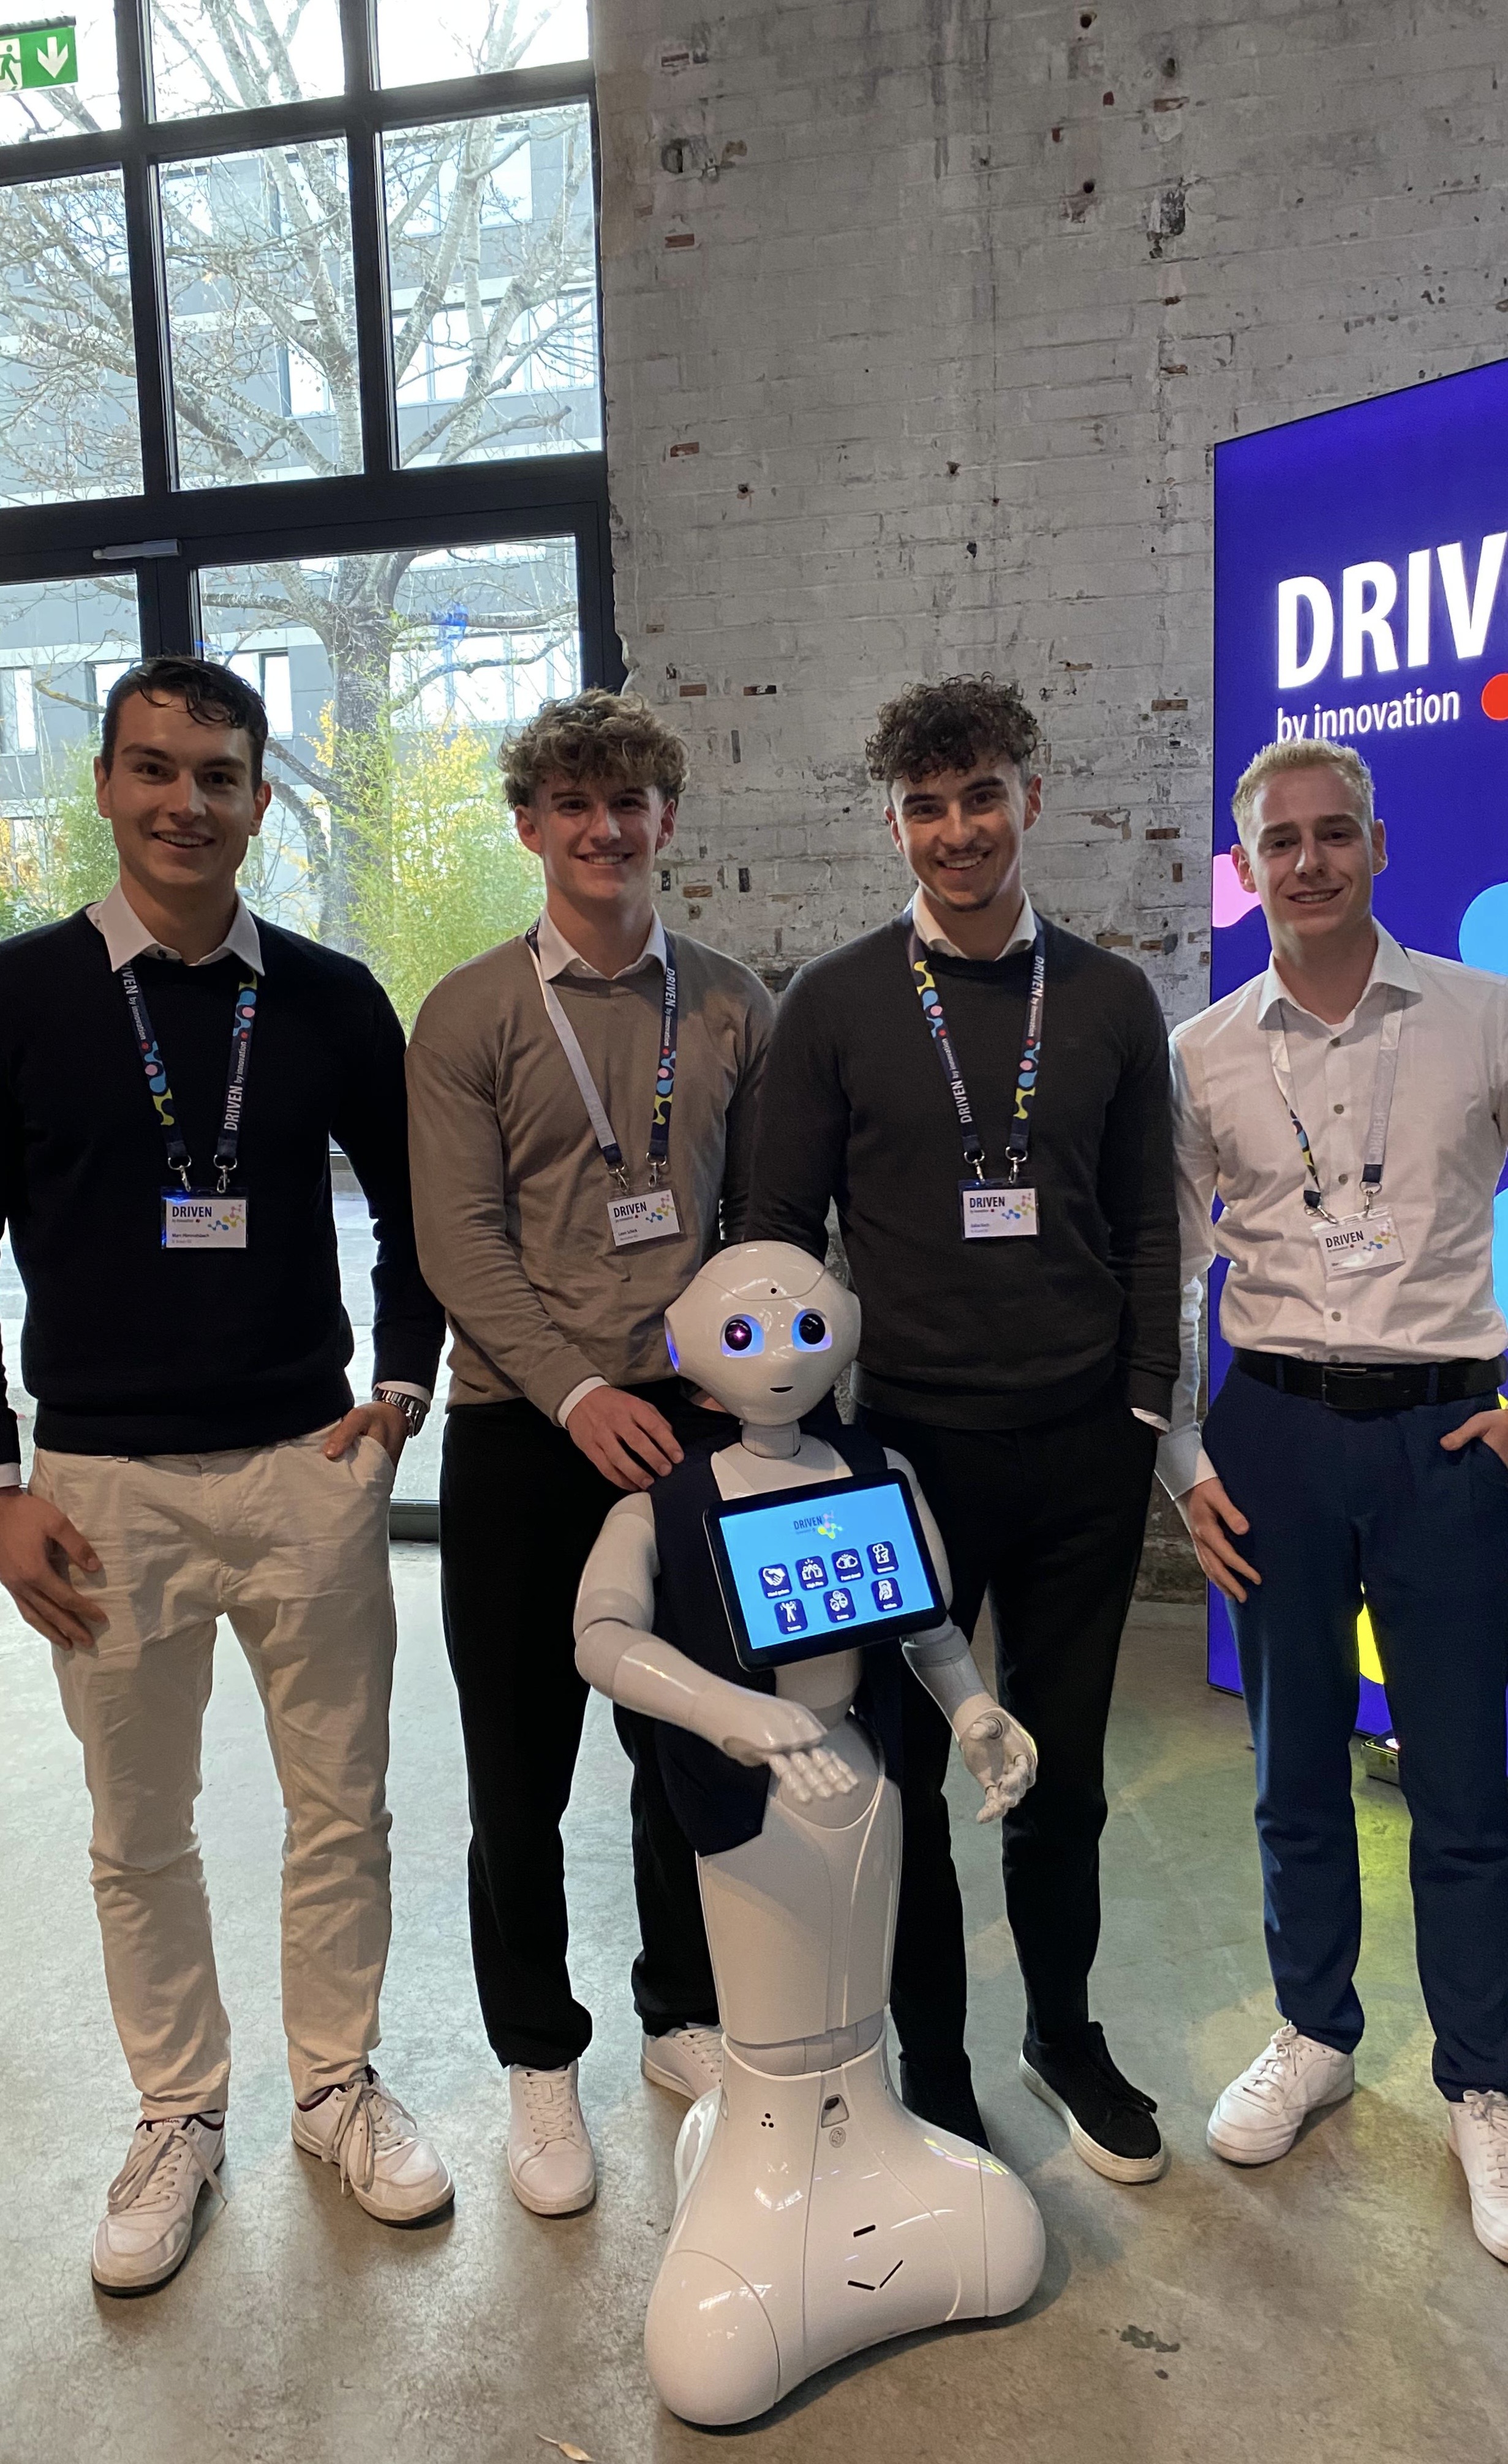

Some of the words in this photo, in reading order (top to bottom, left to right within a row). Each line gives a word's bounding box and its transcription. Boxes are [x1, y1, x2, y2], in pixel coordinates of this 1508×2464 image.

[1278, 531, 1507, 689] DRIV
[1277, 707, 1307, 745] by
[1314, 688, 1460, 740] innovation
[665, 967, 676, 1007] DRIVEN
[1031, 955, 1044, 997] DRIVEN
[128, 996, 137, 1005] by
[235, 1041, 247, 1075] innovation
[233, 1075, 244, 1084] by
[224, 1085, 243, 1132] DRIVEN
[950, 1080, 973, 1124] DRIVEN
[172, 1206, 212, 1218] DRIVEN
[613, 1201, 647, 1218] DRIVEN
[970, 1196, 1005, 1208] DRIVEN
[1325, 1230, 1364, 1248] DRIVEN
[793, 1516, 823, 1530] DRIVEN
